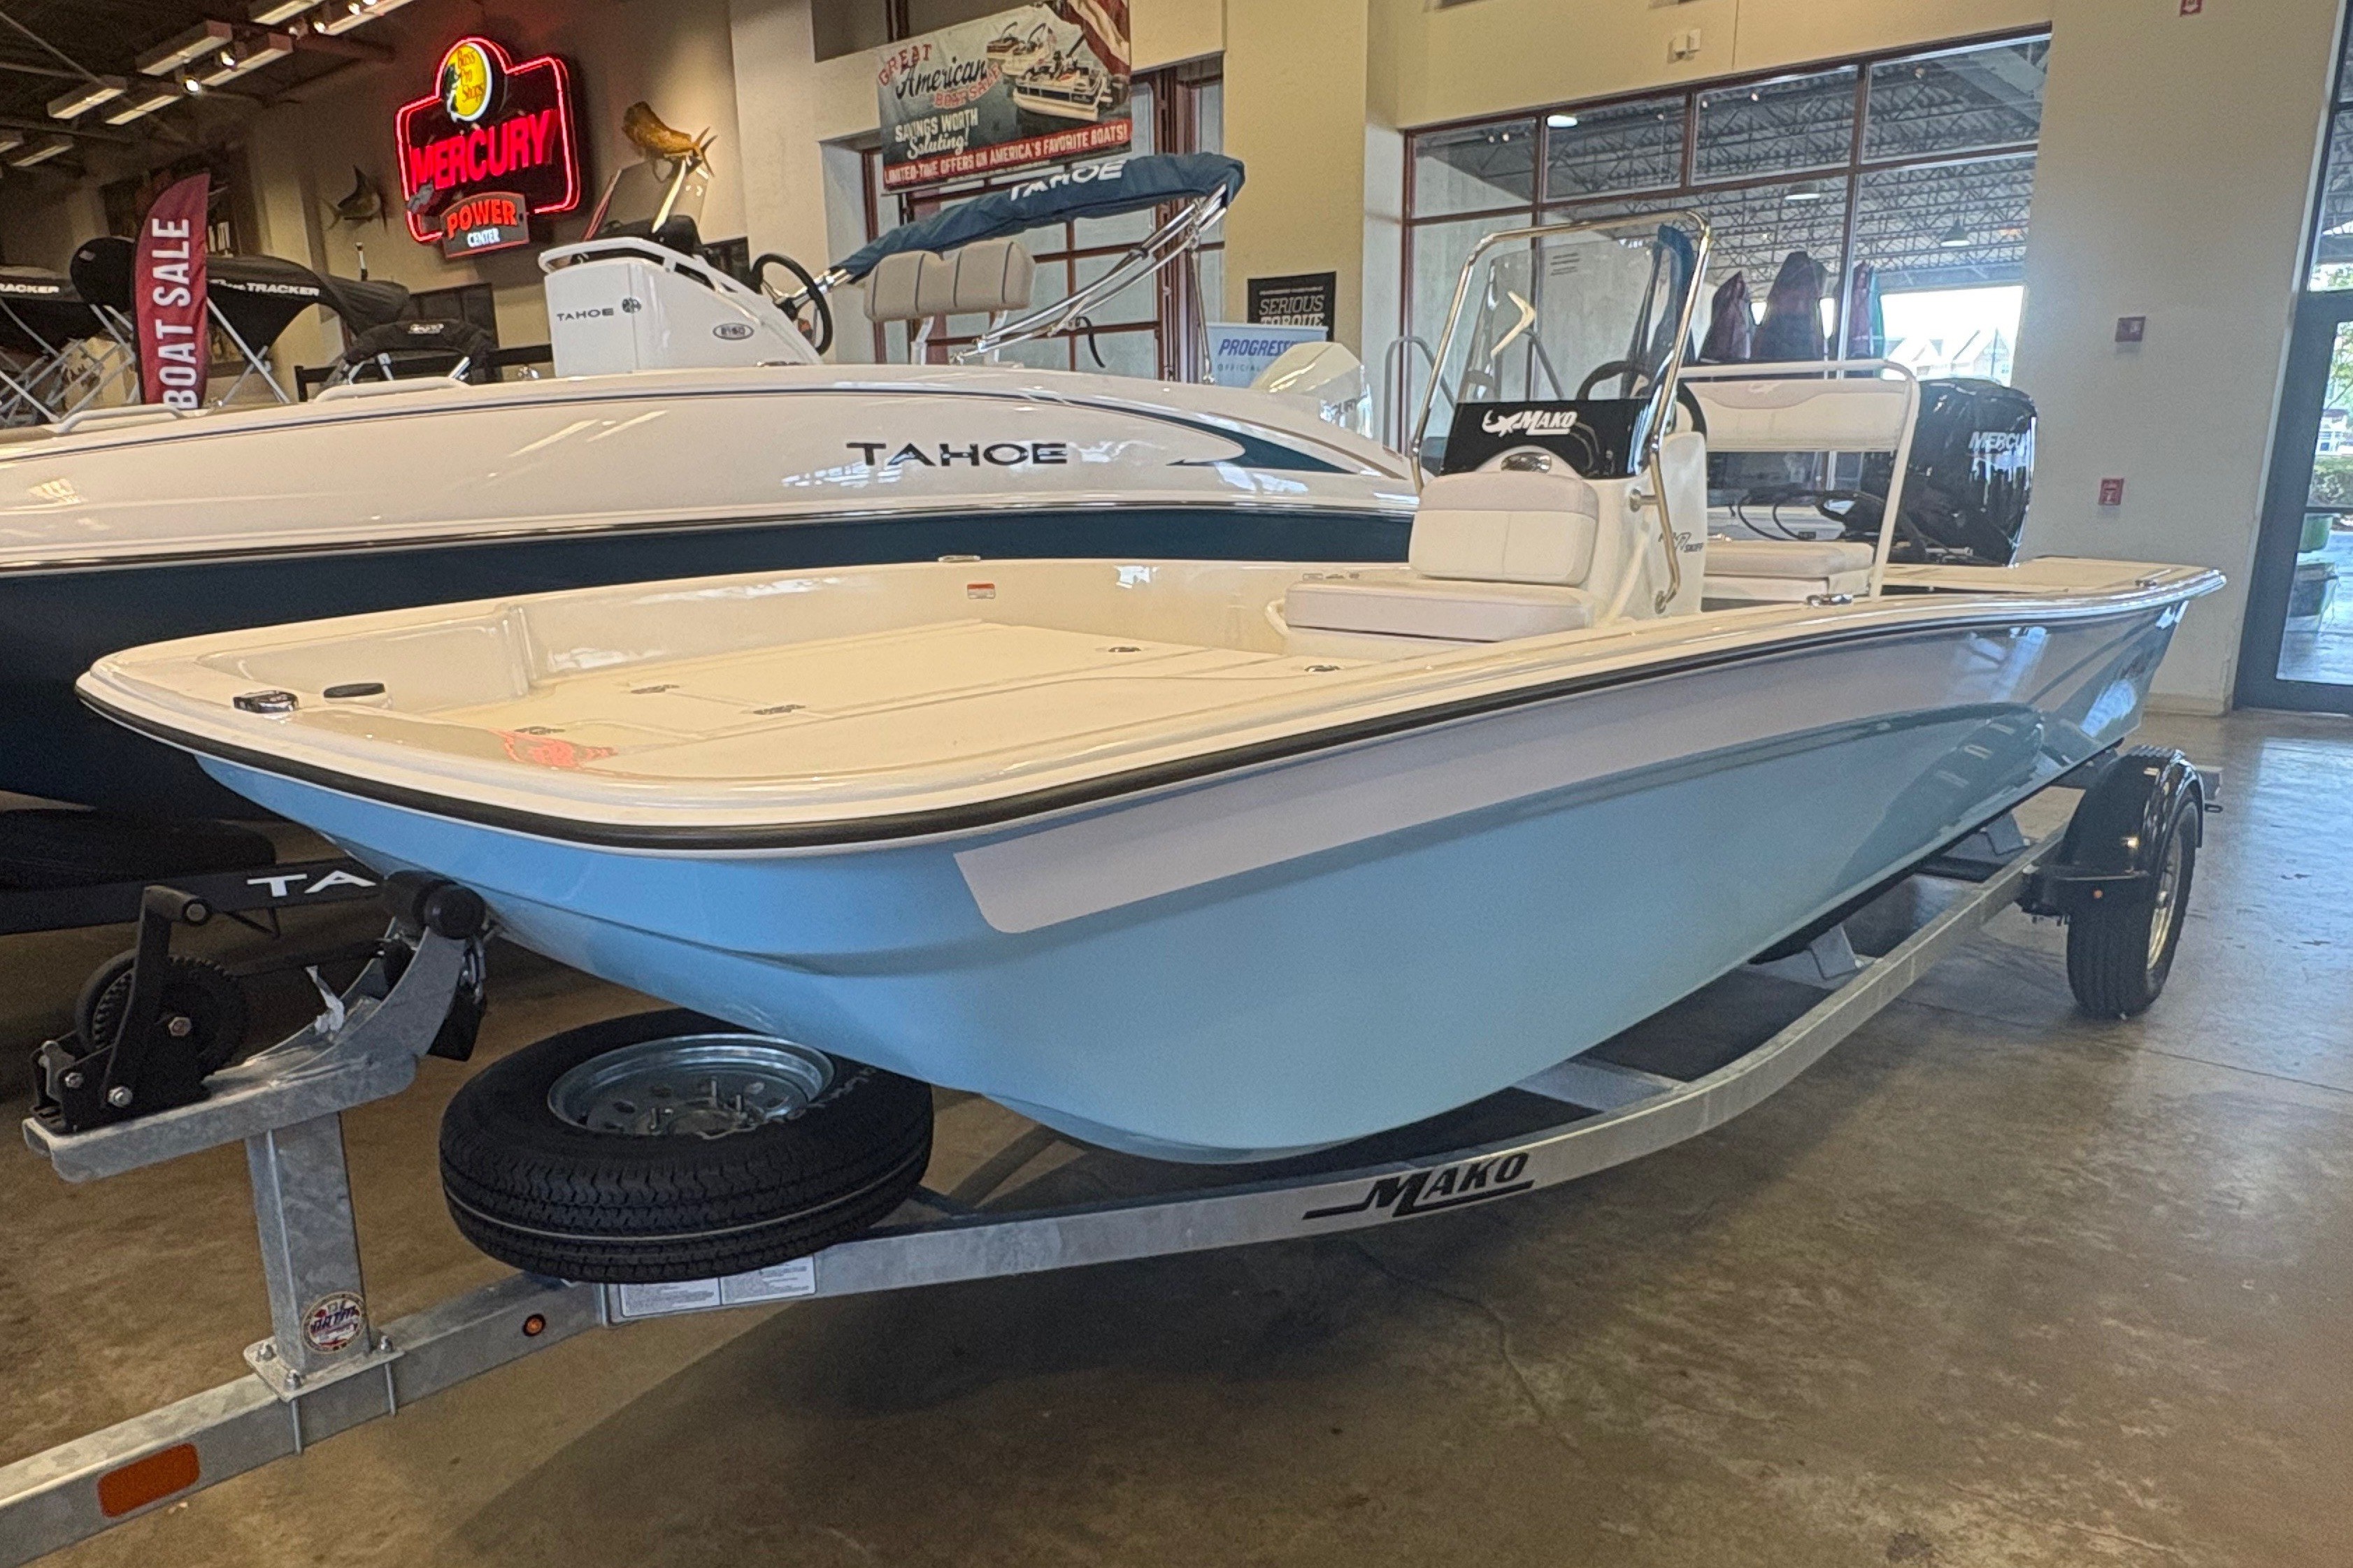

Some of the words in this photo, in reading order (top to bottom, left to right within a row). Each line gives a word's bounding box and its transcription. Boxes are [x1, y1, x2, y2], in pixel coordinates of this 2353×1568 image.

[457, 50, 475, 69] Bass
[878, 43, 932, 86] GREAT
[896, 56, 987, 99] American
[934, 92, 966, 106] BOAT
[969, 62, 1000, 99] SALE
[895, 116, 938, 143] SAVINGS
[941, 107, 979, 133] WORTH
[907, 124, 969, 159] Saluting!
[410, 110, 552, 194] MERCURY
[885, 161, 938, 184] LIMITED-TIME
[941, 154, 974, 175] OFFERS
[975, 151, 987, 168] ON
[989, 141, 1042, 164] AMERICA'S
[1043, 131, 1089, 155] FAVORITE
[1091, 122, 1128, 145] BOATS!
[1010, 159, 1128, 201] TAHOE
[447, 199, 517, 239] POWER
[467, 228, 501, 247] CENTER
[151, 218, 191, 306] SALE
[0, 282, 59, 294] RACKER
[247, 282, 320, 296] TRACKER
[1259, 294, 1325, 315] SERIOUS
[557, 308, 614, 322] TAHOE
[155, 319, 199, 410] BOAT
[1512, 410, 1578, 436] MAKO
[846, 442, 1068, 466] TAHOE
[1302, 1152, 1534, 1217] MAKO
